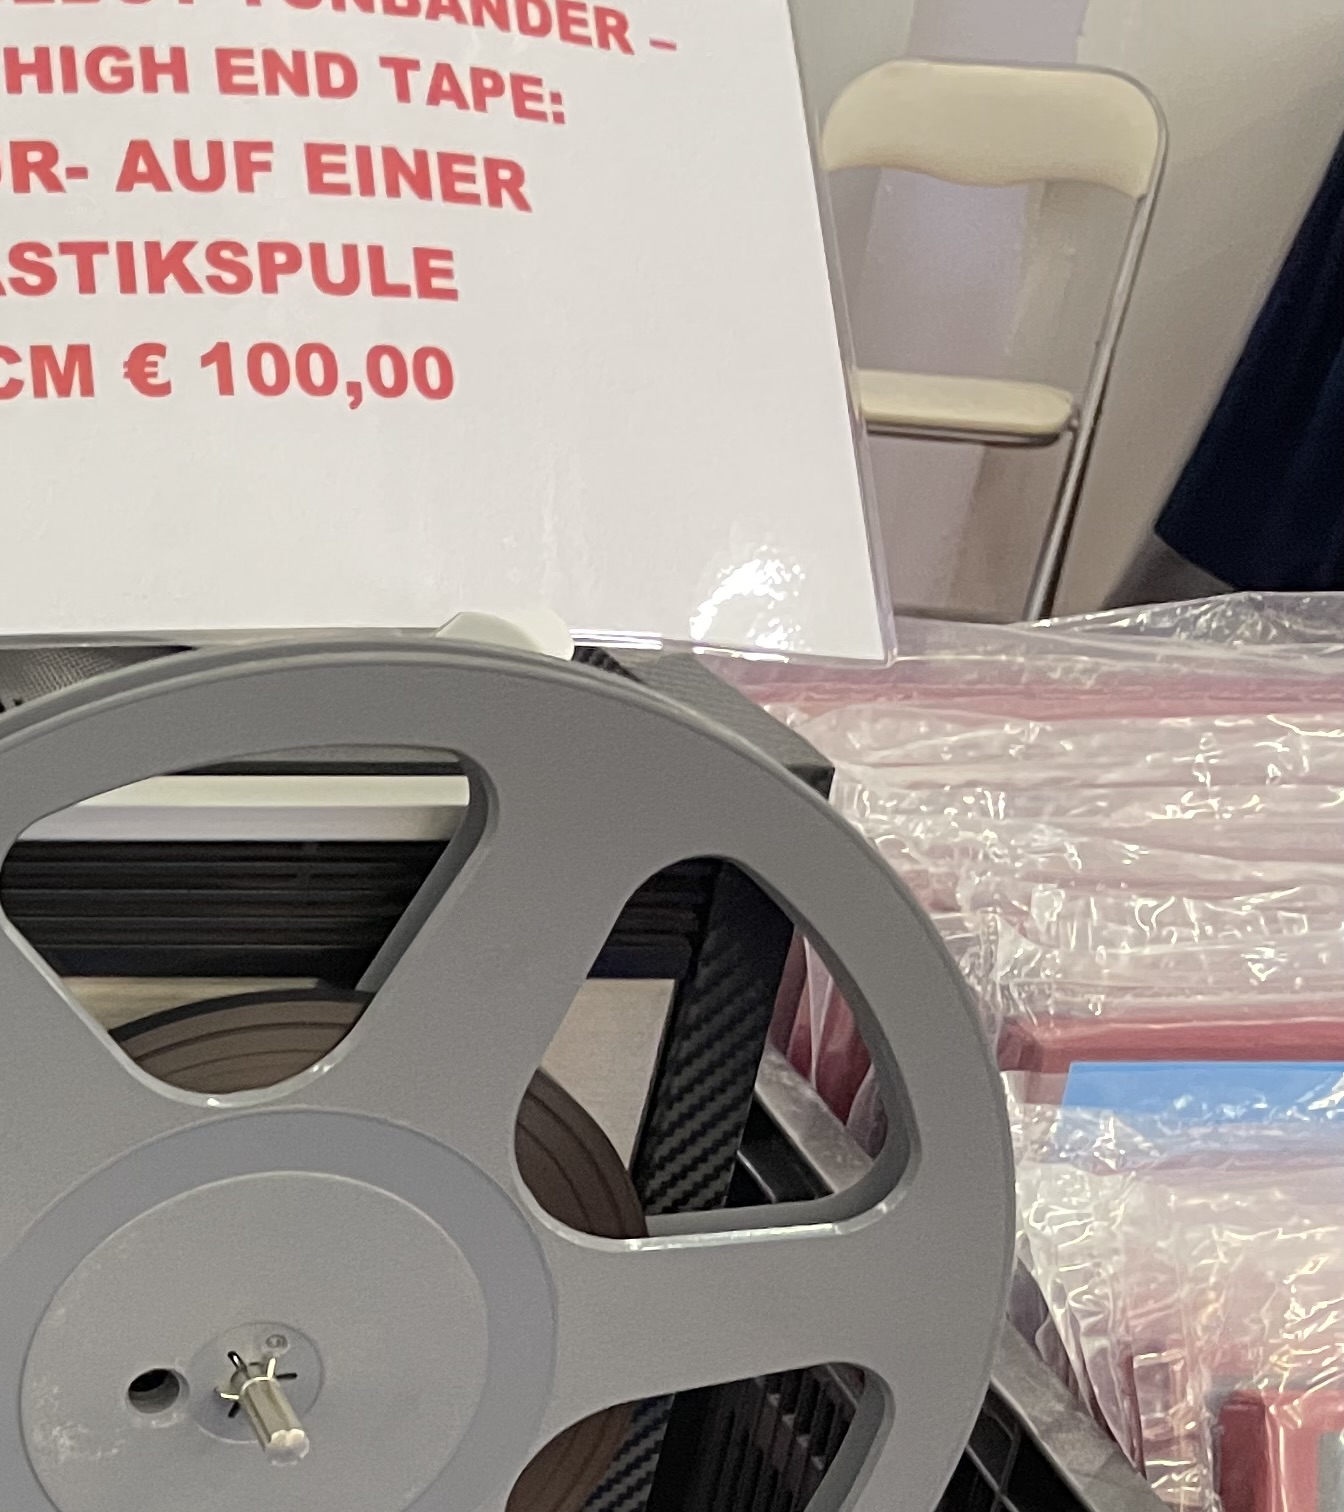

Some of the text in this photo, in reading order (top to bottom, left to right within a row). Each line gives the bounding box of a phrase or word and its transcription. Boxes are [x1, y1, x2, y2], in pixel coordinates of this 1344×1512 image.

[3, 45, 189, 95] HIGH
[214, 46, 359, 99] END
[378, 56, 566, 126] TAPE:
[116, 138, 275, 193] AUF
[303, 142, 531, 212] EINER
[123, 342, 172, 399] €
[200, 341, 455, 410] 100,00
